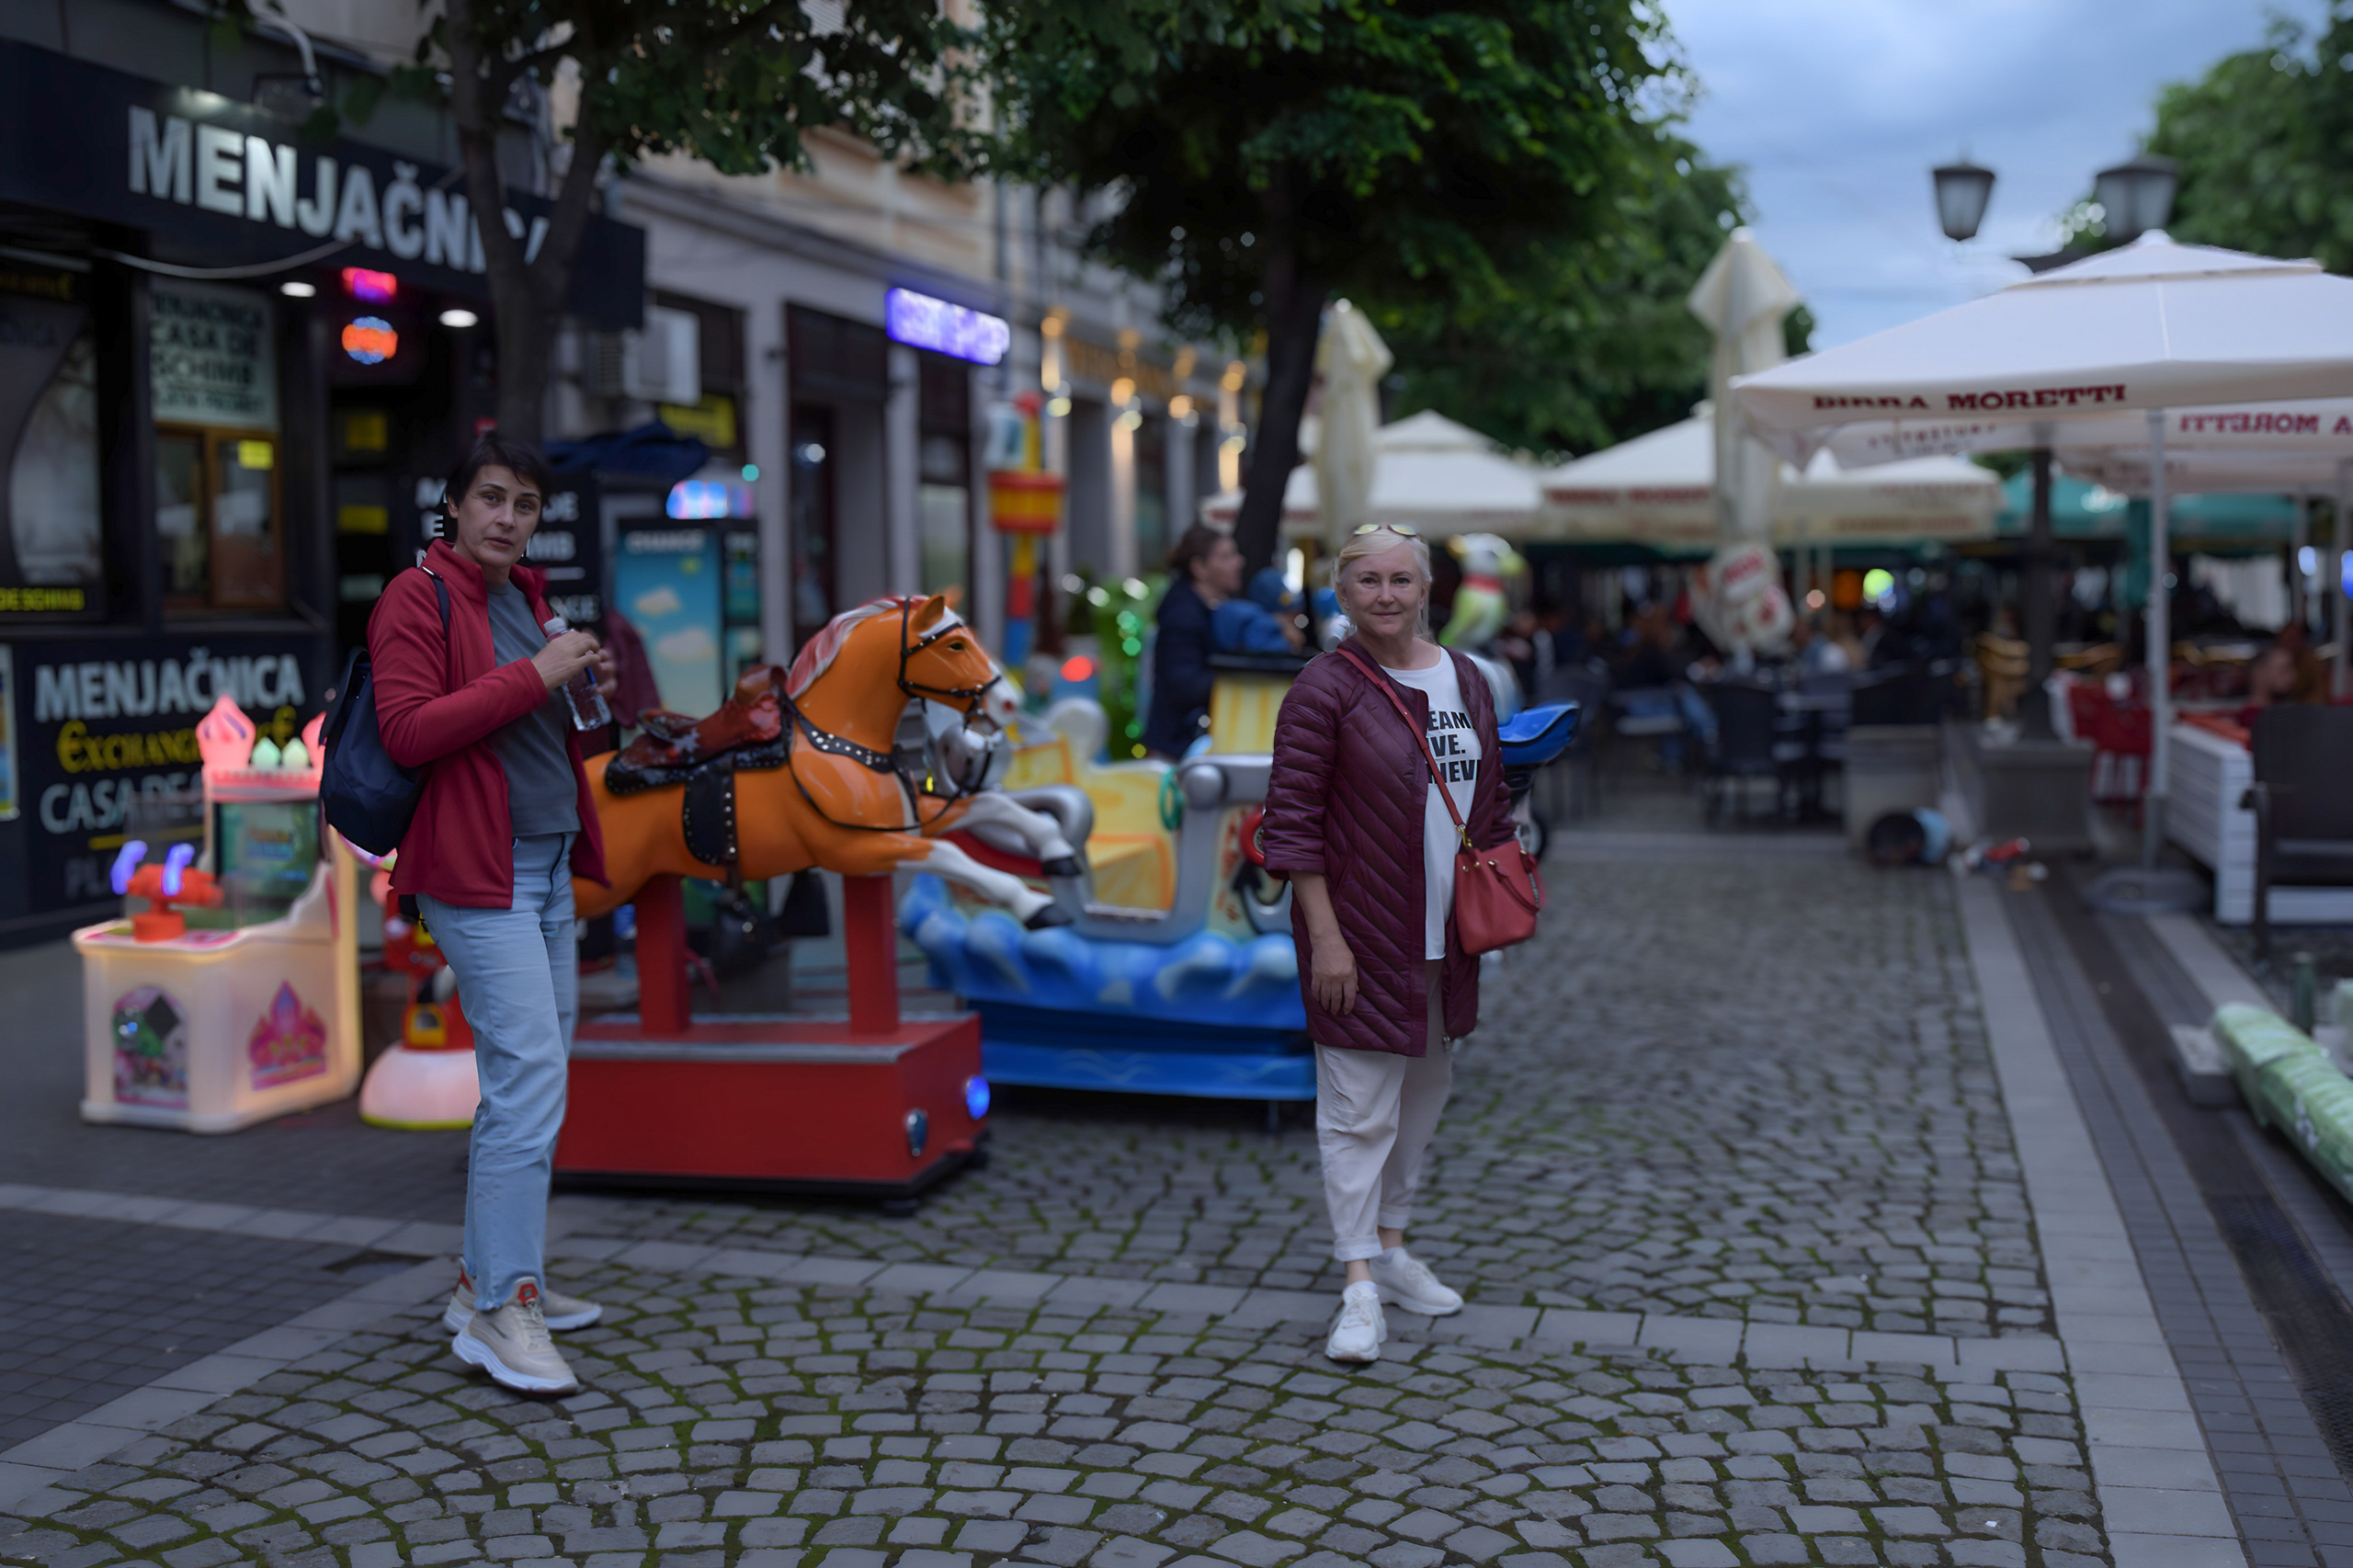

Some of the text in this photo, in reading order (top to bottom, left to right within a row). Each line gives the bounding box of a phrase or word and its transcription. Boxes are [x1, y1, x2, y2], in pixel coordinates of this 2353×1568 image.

[1946, 384, 2127, 411] MORETTI
[35, 646, 305, 722] MENJAČNICA
[1427, 710, 1476, 732] EAM
